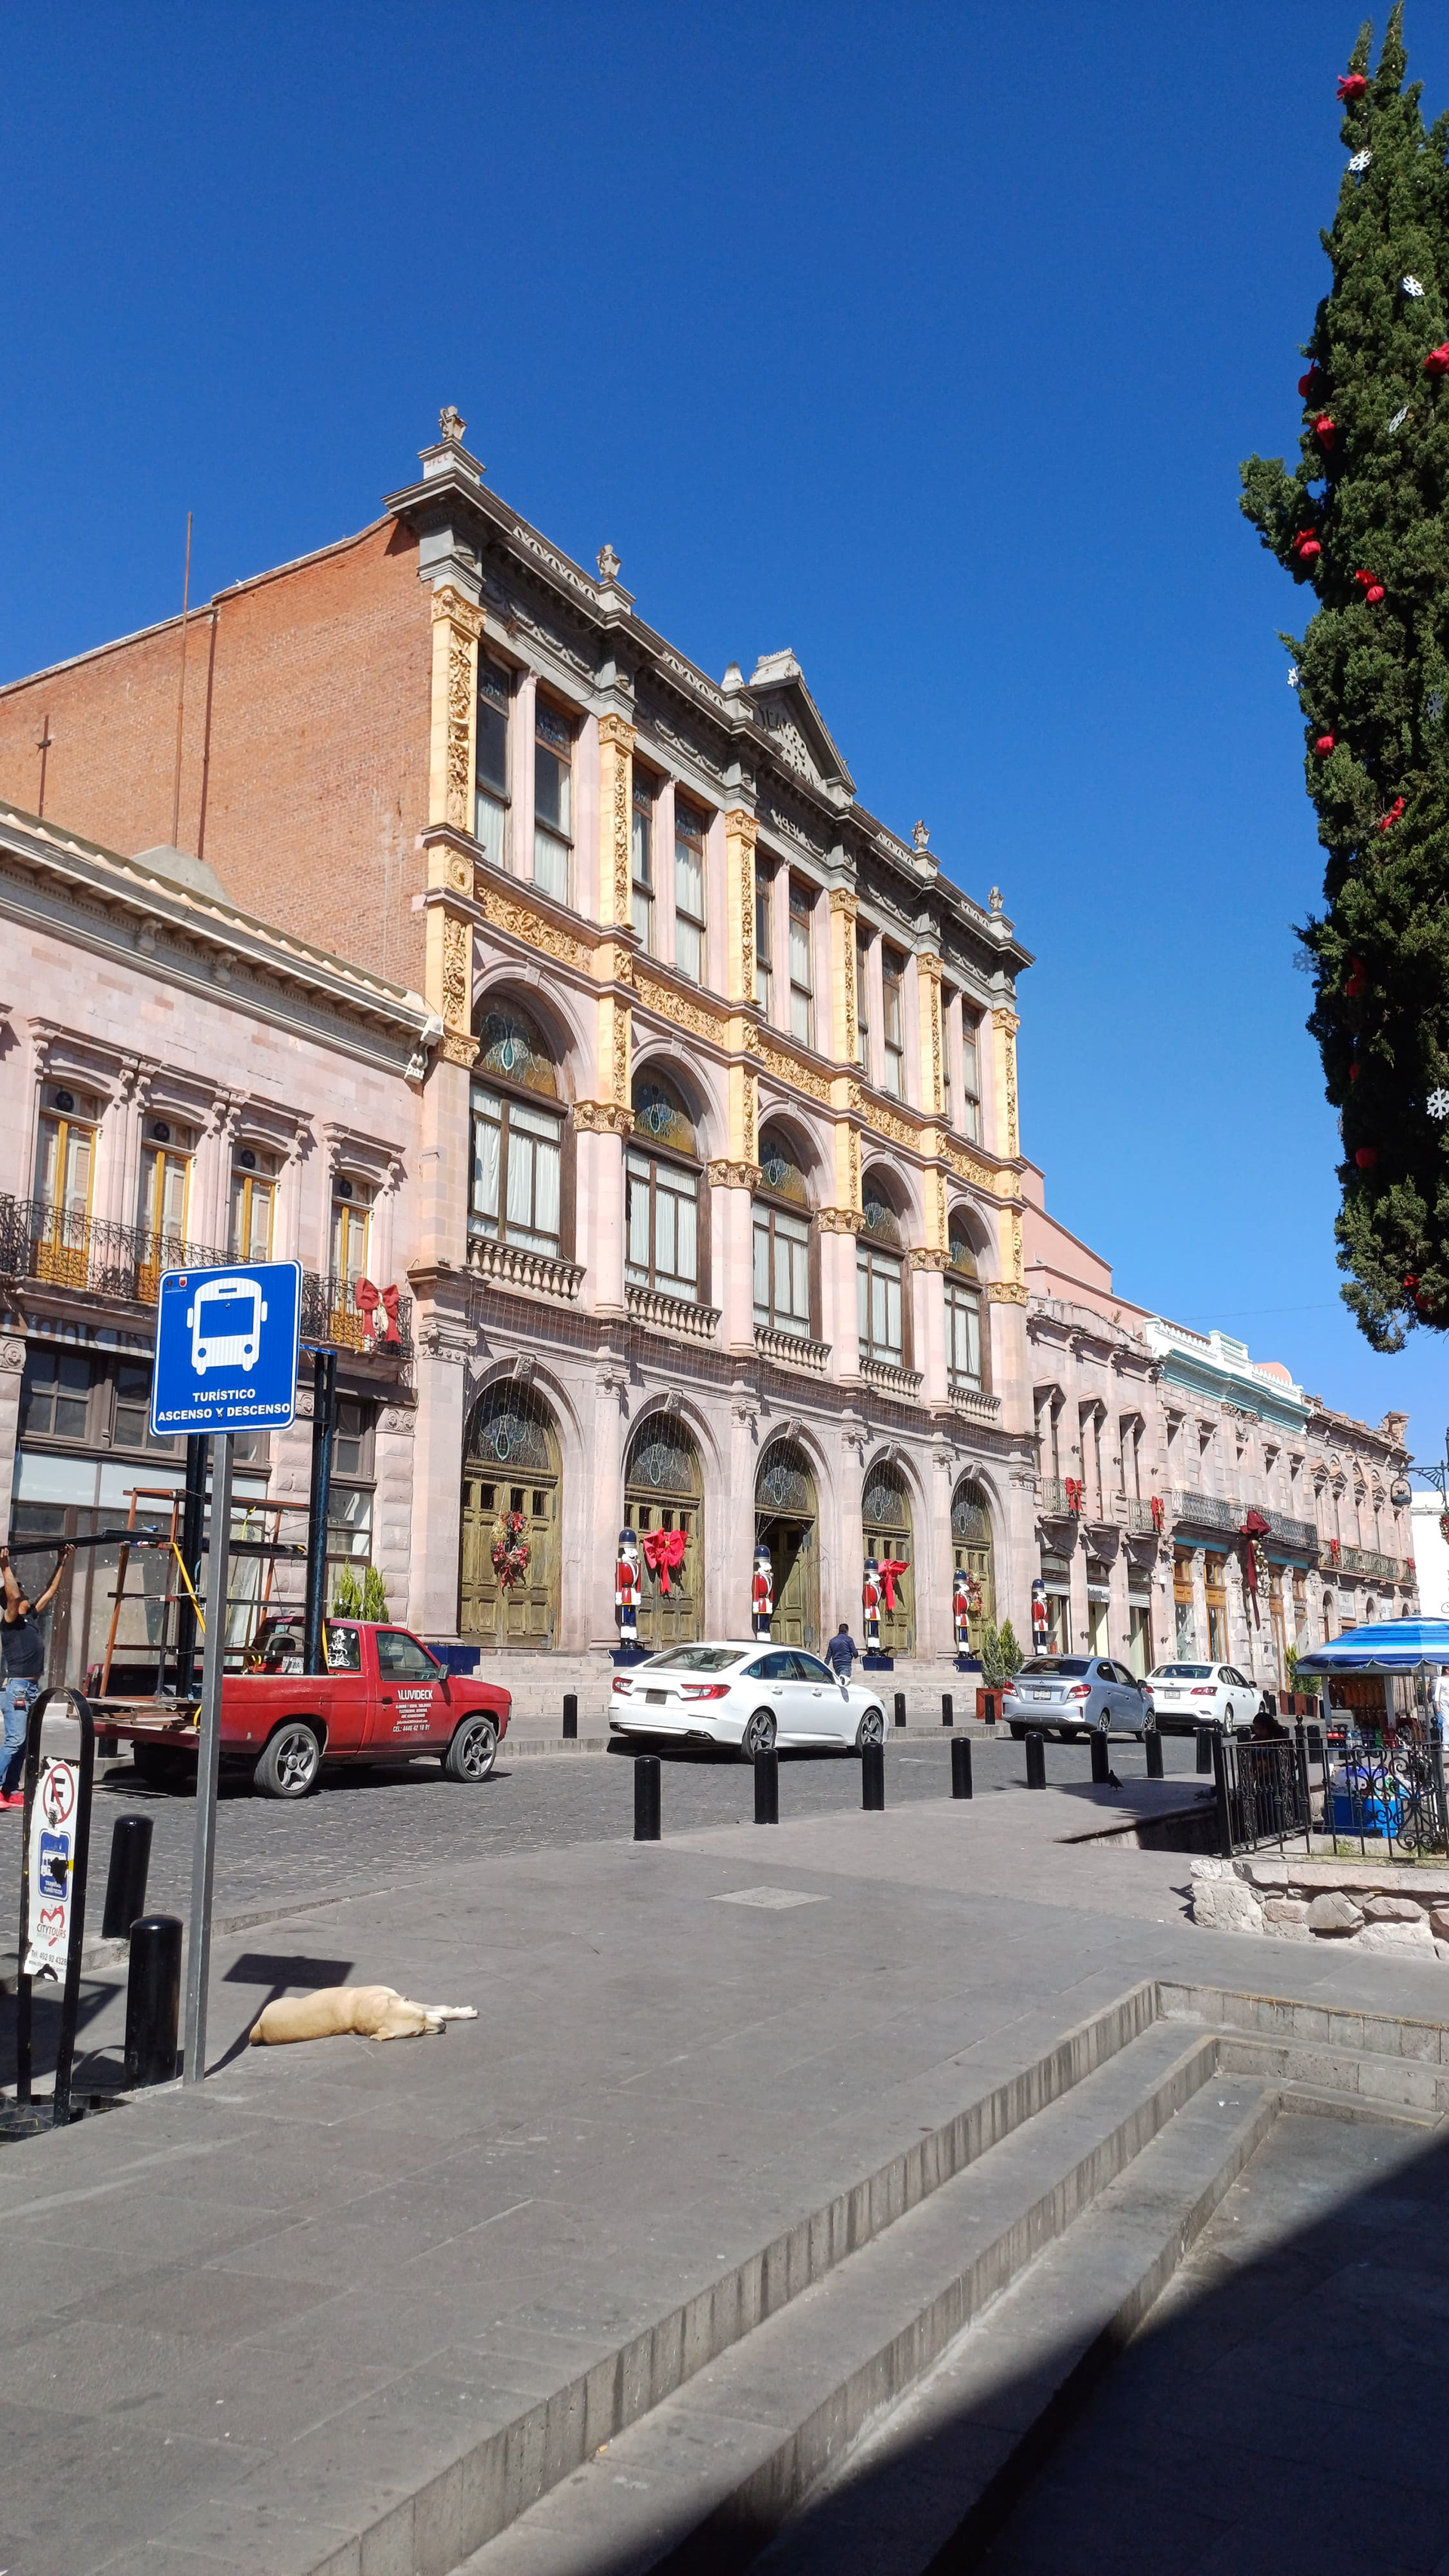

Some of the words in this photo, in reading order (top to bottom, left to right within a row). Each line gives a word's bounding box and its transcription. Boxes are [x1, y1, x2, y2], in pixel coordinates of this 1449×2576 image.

[192, 1389, 256, 1402] TURÍSTICO
[158, 1408, 212, 1421] ASCENSO
[216, 1408, 224, 1418] Y
[227, 1403, 291, 1417] DESCENSO
[36, 1923, 66, 1939] CITYTOURS
